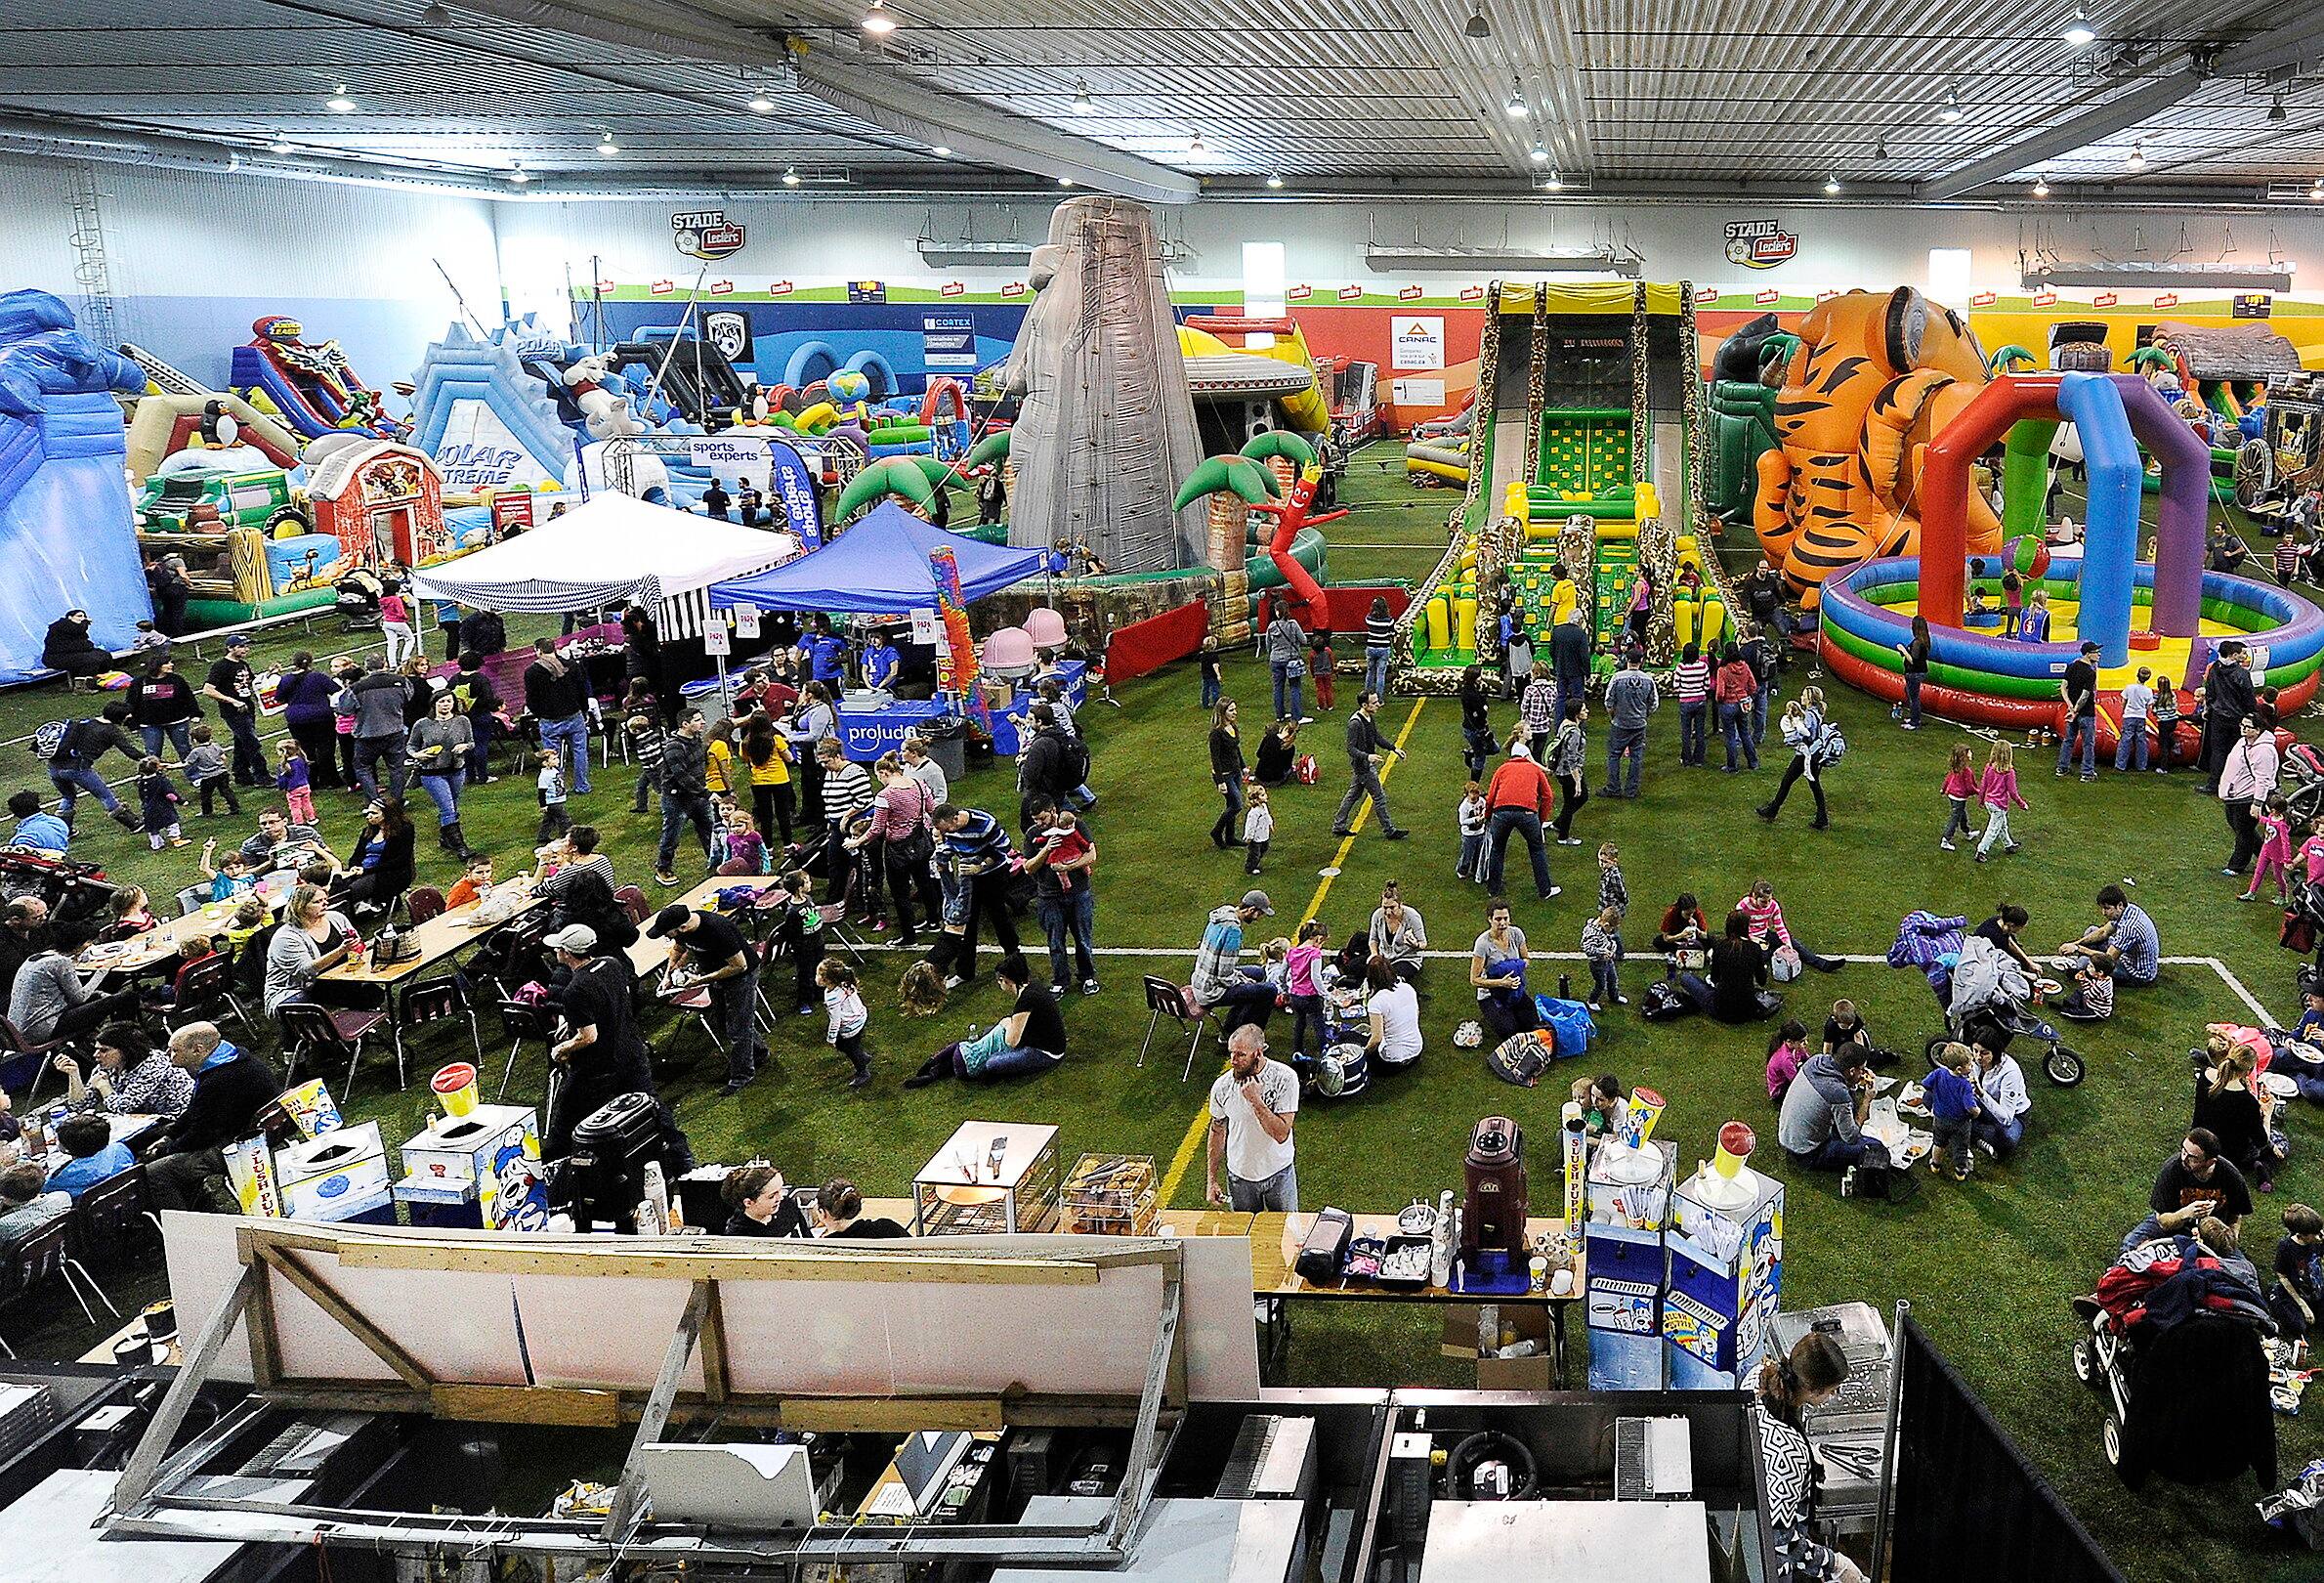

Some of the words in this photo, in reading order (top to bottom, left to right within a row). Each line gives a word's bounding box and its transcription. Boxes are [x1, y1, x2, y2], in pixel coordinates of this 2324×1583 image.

[672, 212, 722, 229] STADE
[1725, 221, 1777, 237] STADE
[706, 232, 739, 243] Leclerc
[1758, 240, 1792, 252] Leclerc
[693, 441, 736, 452] sports
[709, 449, 759, 462] experts
[1570, 1138, 1580, 1181] SLUSH
[251, 1146, 270, 1192] SLUSH
[1570, 1182, 1580, 1233] PUPPIE
